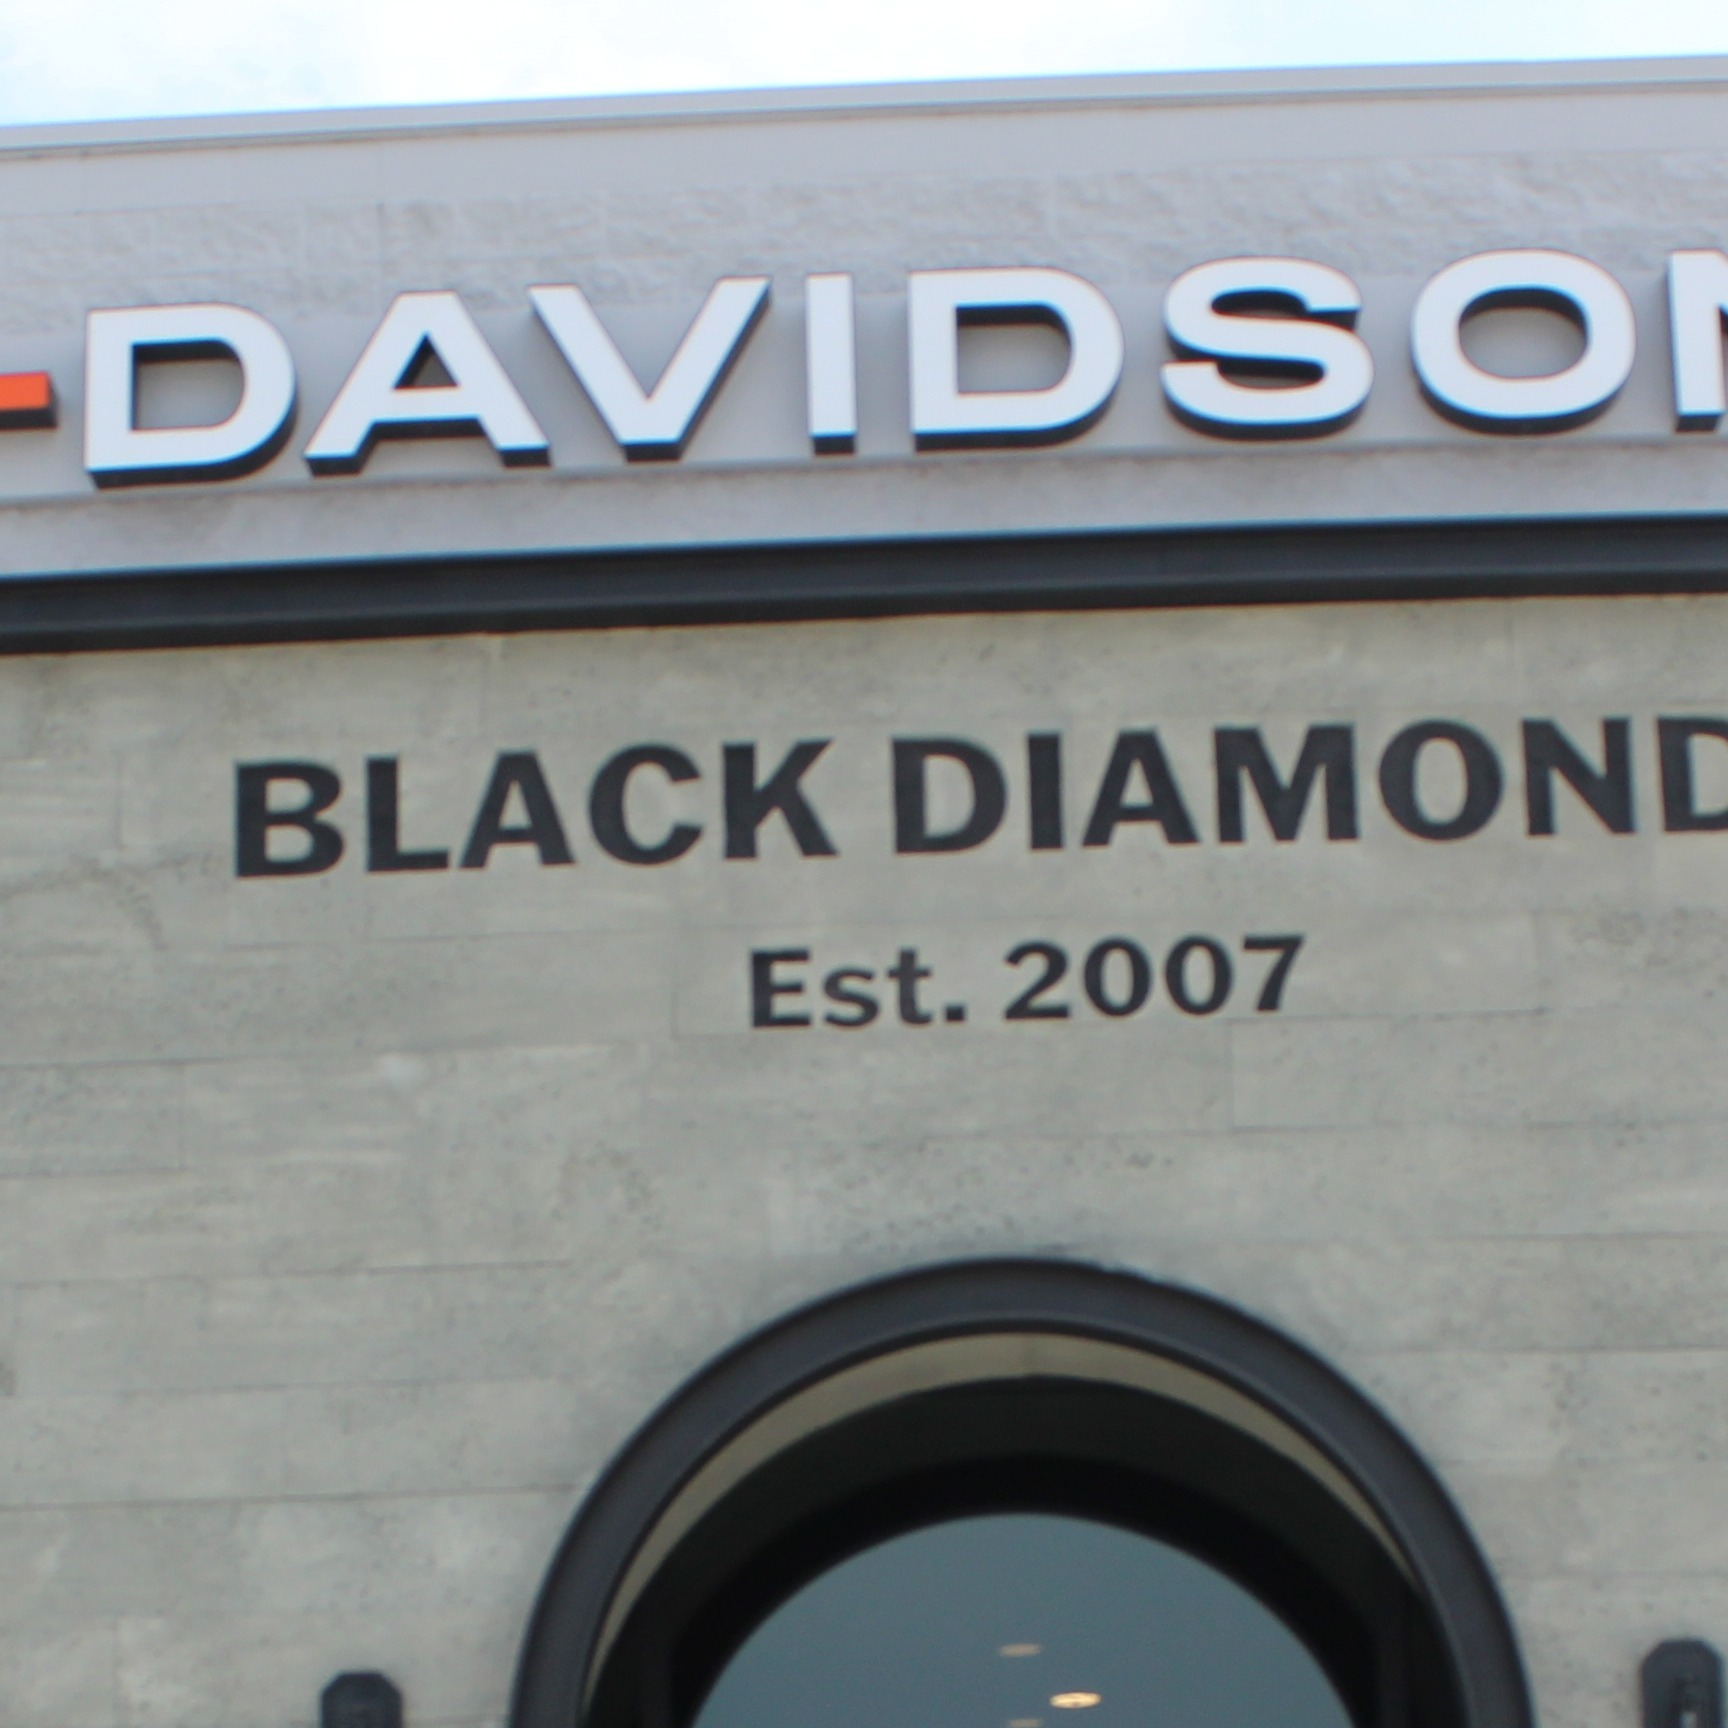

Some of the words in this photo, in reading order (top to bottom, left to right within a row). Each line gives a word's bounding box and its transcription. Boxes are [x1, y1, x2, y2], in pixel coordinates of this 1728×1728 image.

[234, 738, 838, 880] BLACK
[750, 947, 967, 1030] Est.
[1004, 934, 1304, 1022] 2007
